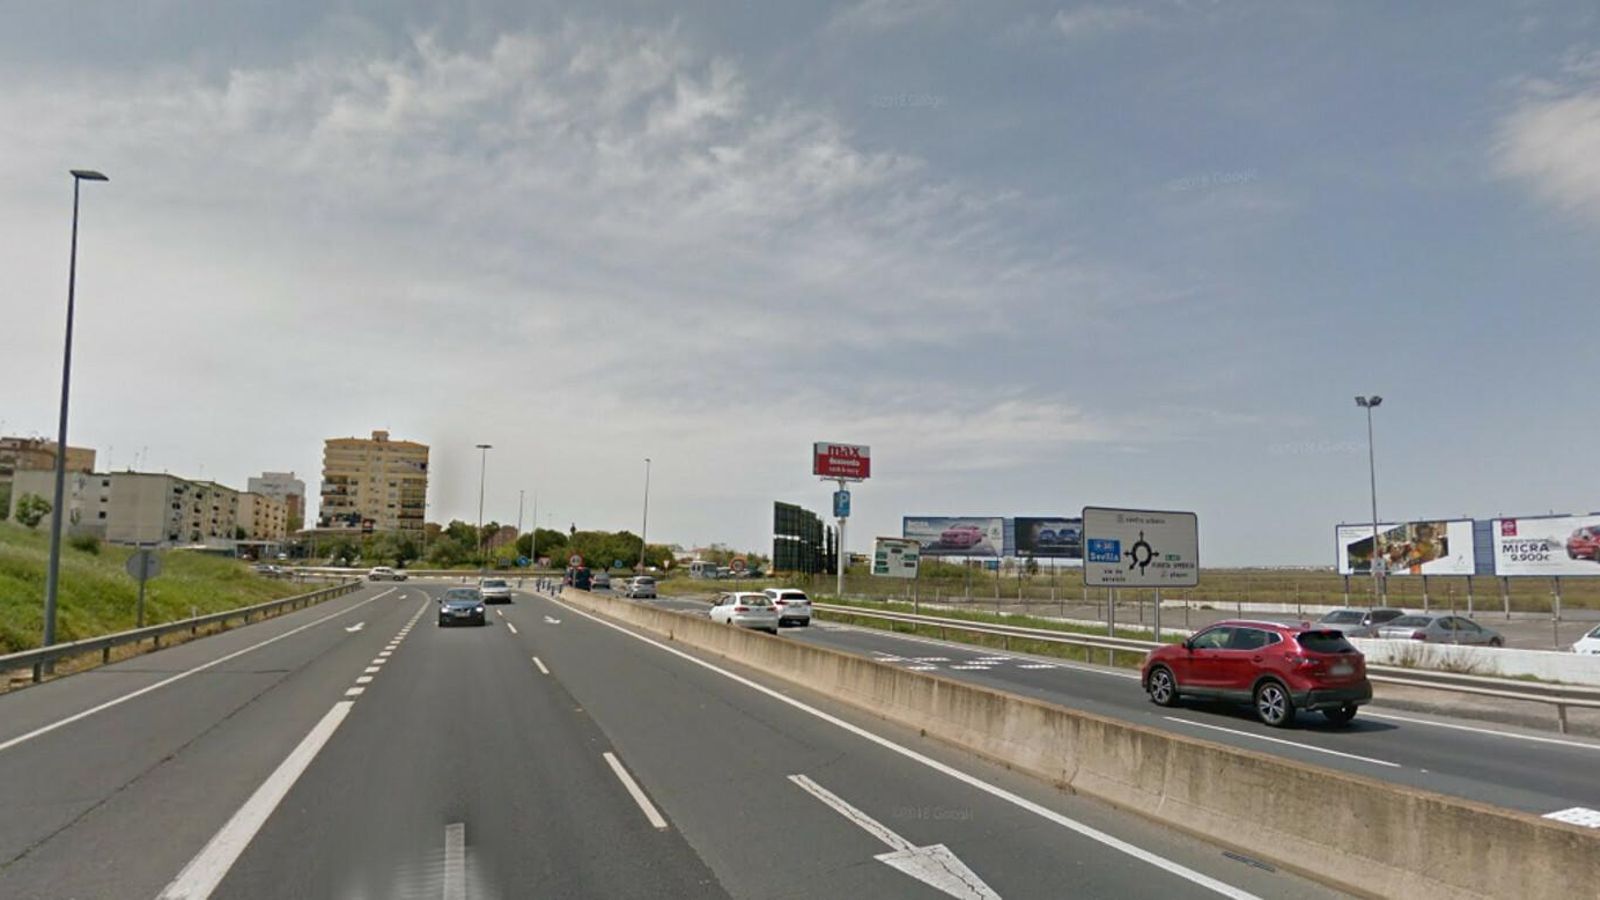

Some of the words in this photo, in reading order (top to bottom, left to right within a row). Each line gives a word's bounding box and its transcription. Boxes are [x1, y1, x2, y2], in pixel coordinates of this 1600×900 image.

[828, 445, 860, 459] max
[840, 492, 849, 508] P
[1502, 543, 1549, 553] MICRA
[1090, 552, 1119, 561] Sevilla
